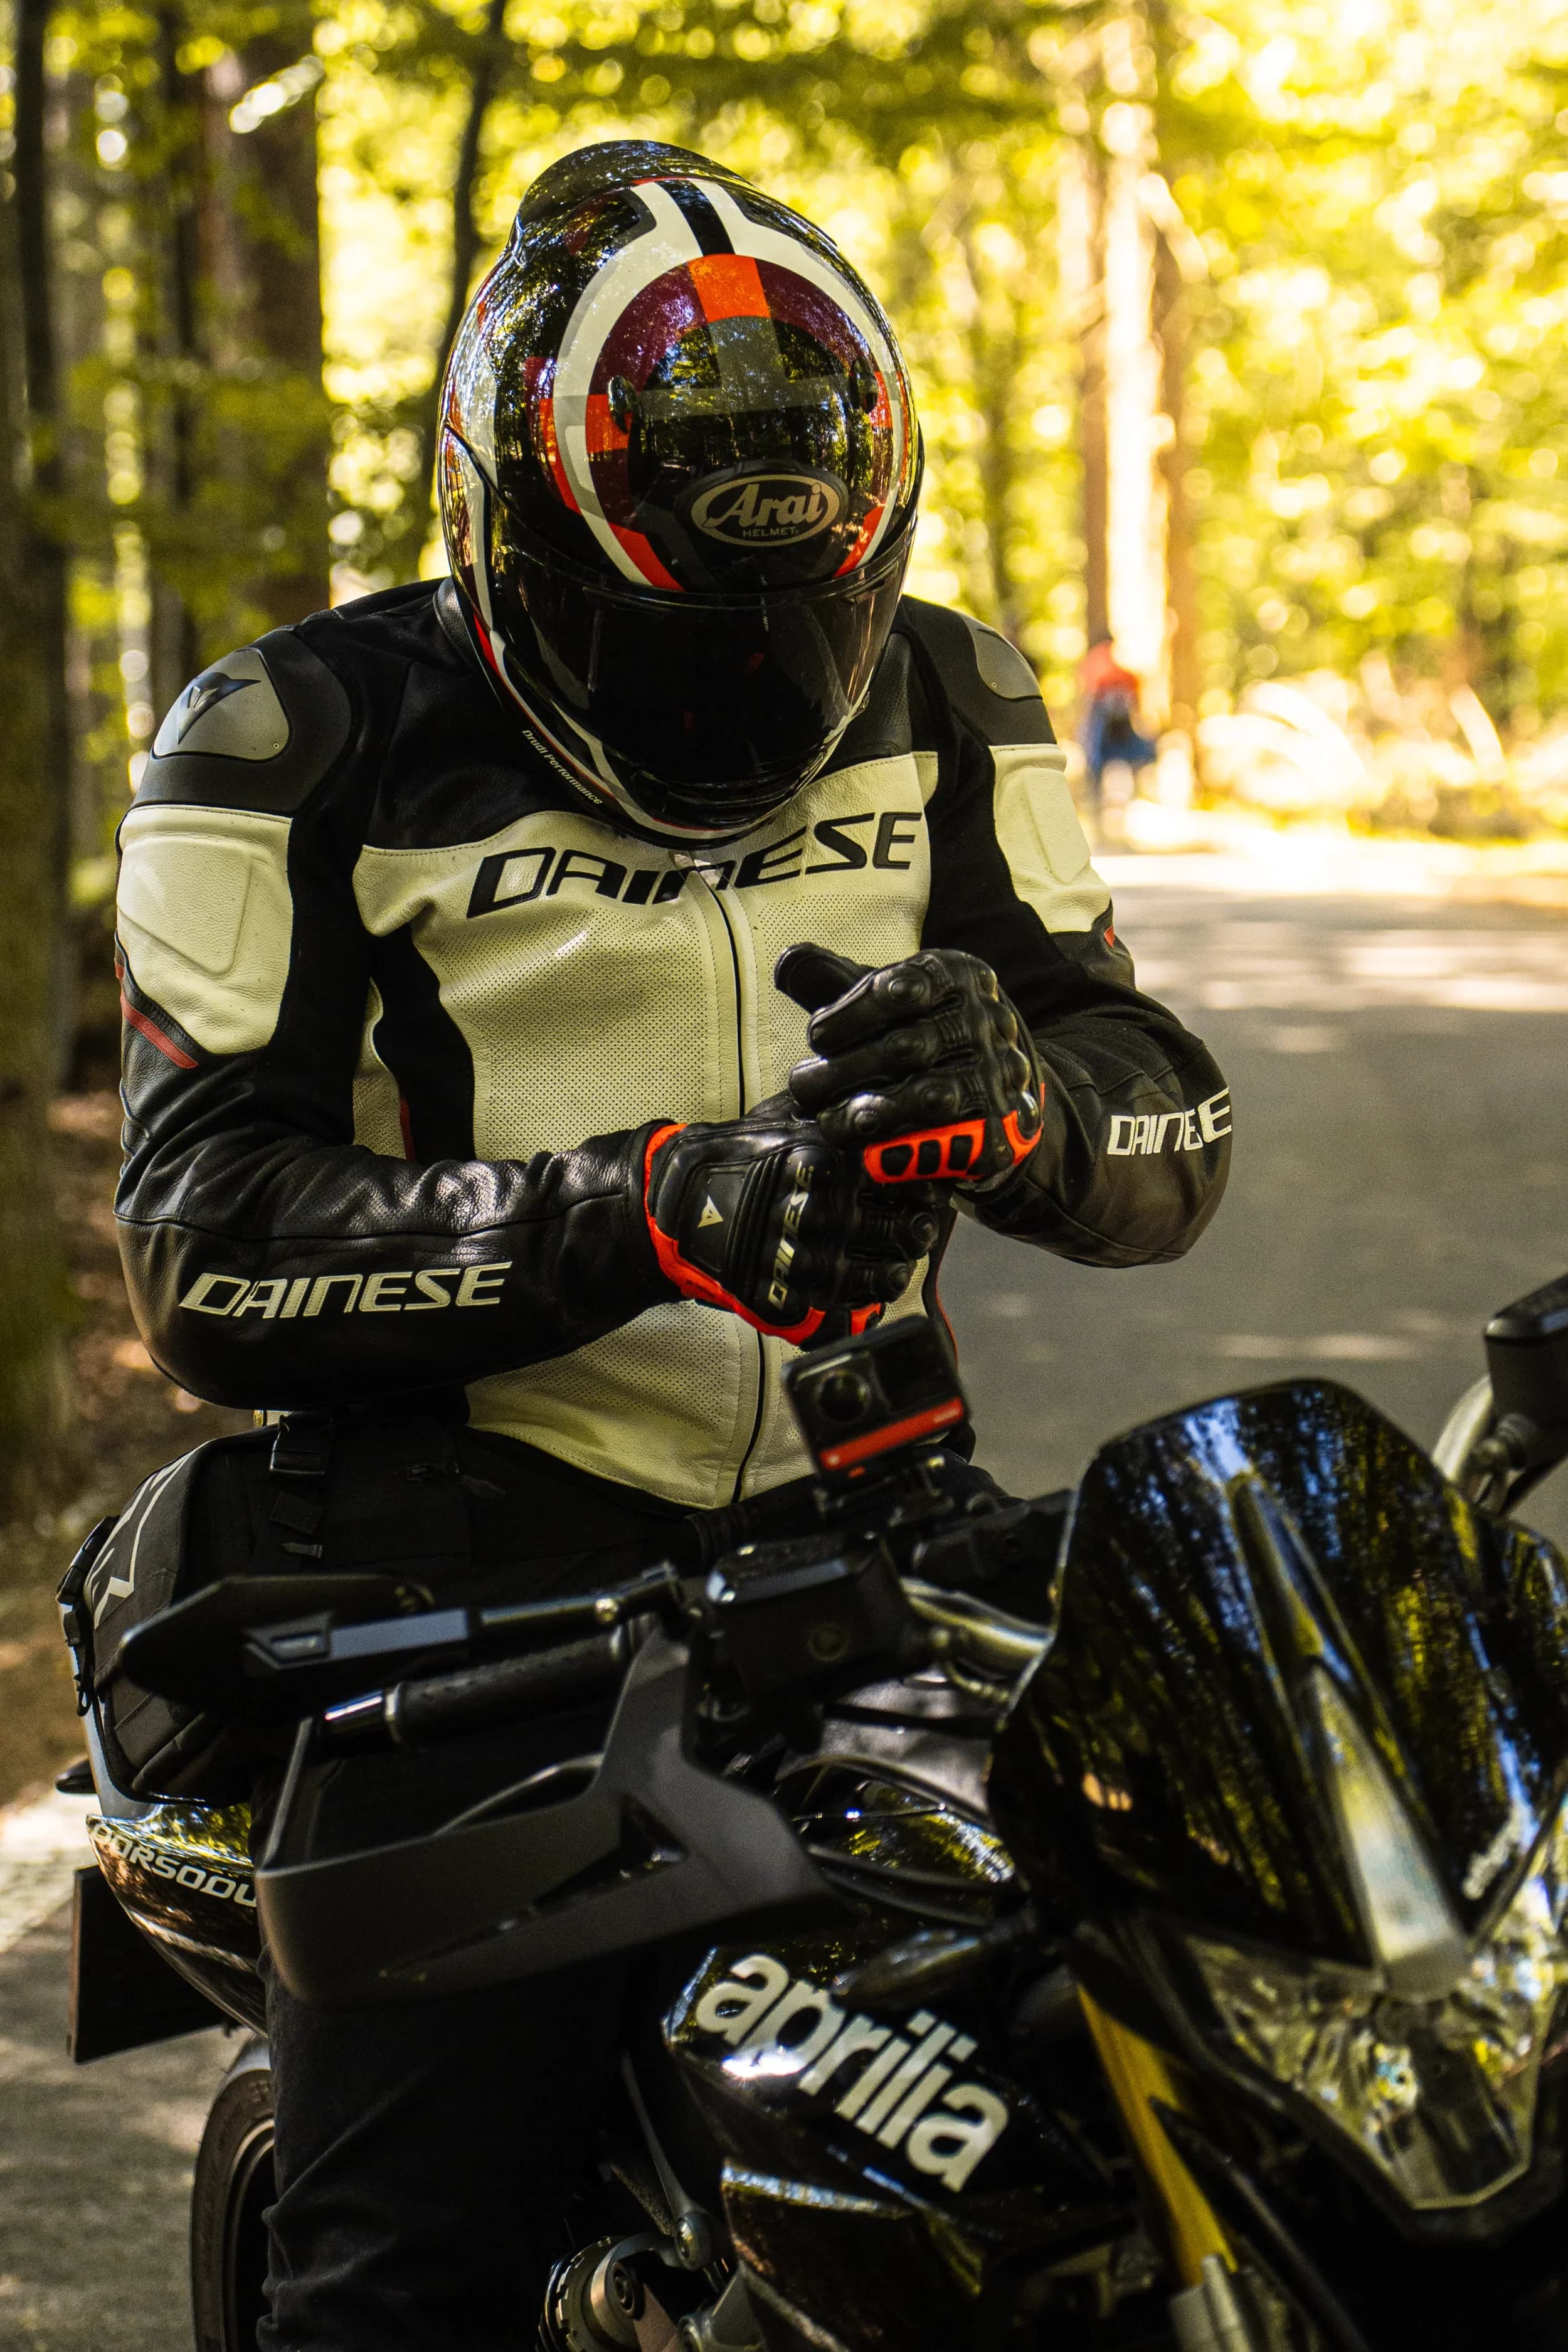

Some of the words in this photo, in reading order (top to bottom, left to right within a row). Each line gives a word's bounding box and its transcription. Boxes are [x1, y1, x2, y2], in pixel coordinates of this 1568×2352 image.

[701, 483, 823, 528] Arai
[742, 526, 797, 538] HELMET
[544, 754, 603, 804] Performance
[466, 811, 923, 919] DAINESE
[768, 1160, 813, 1311] DAINESE
[178, 1261, 512, 1318] DAINESE
[696, 1954, 1009, 2193] aprilia
